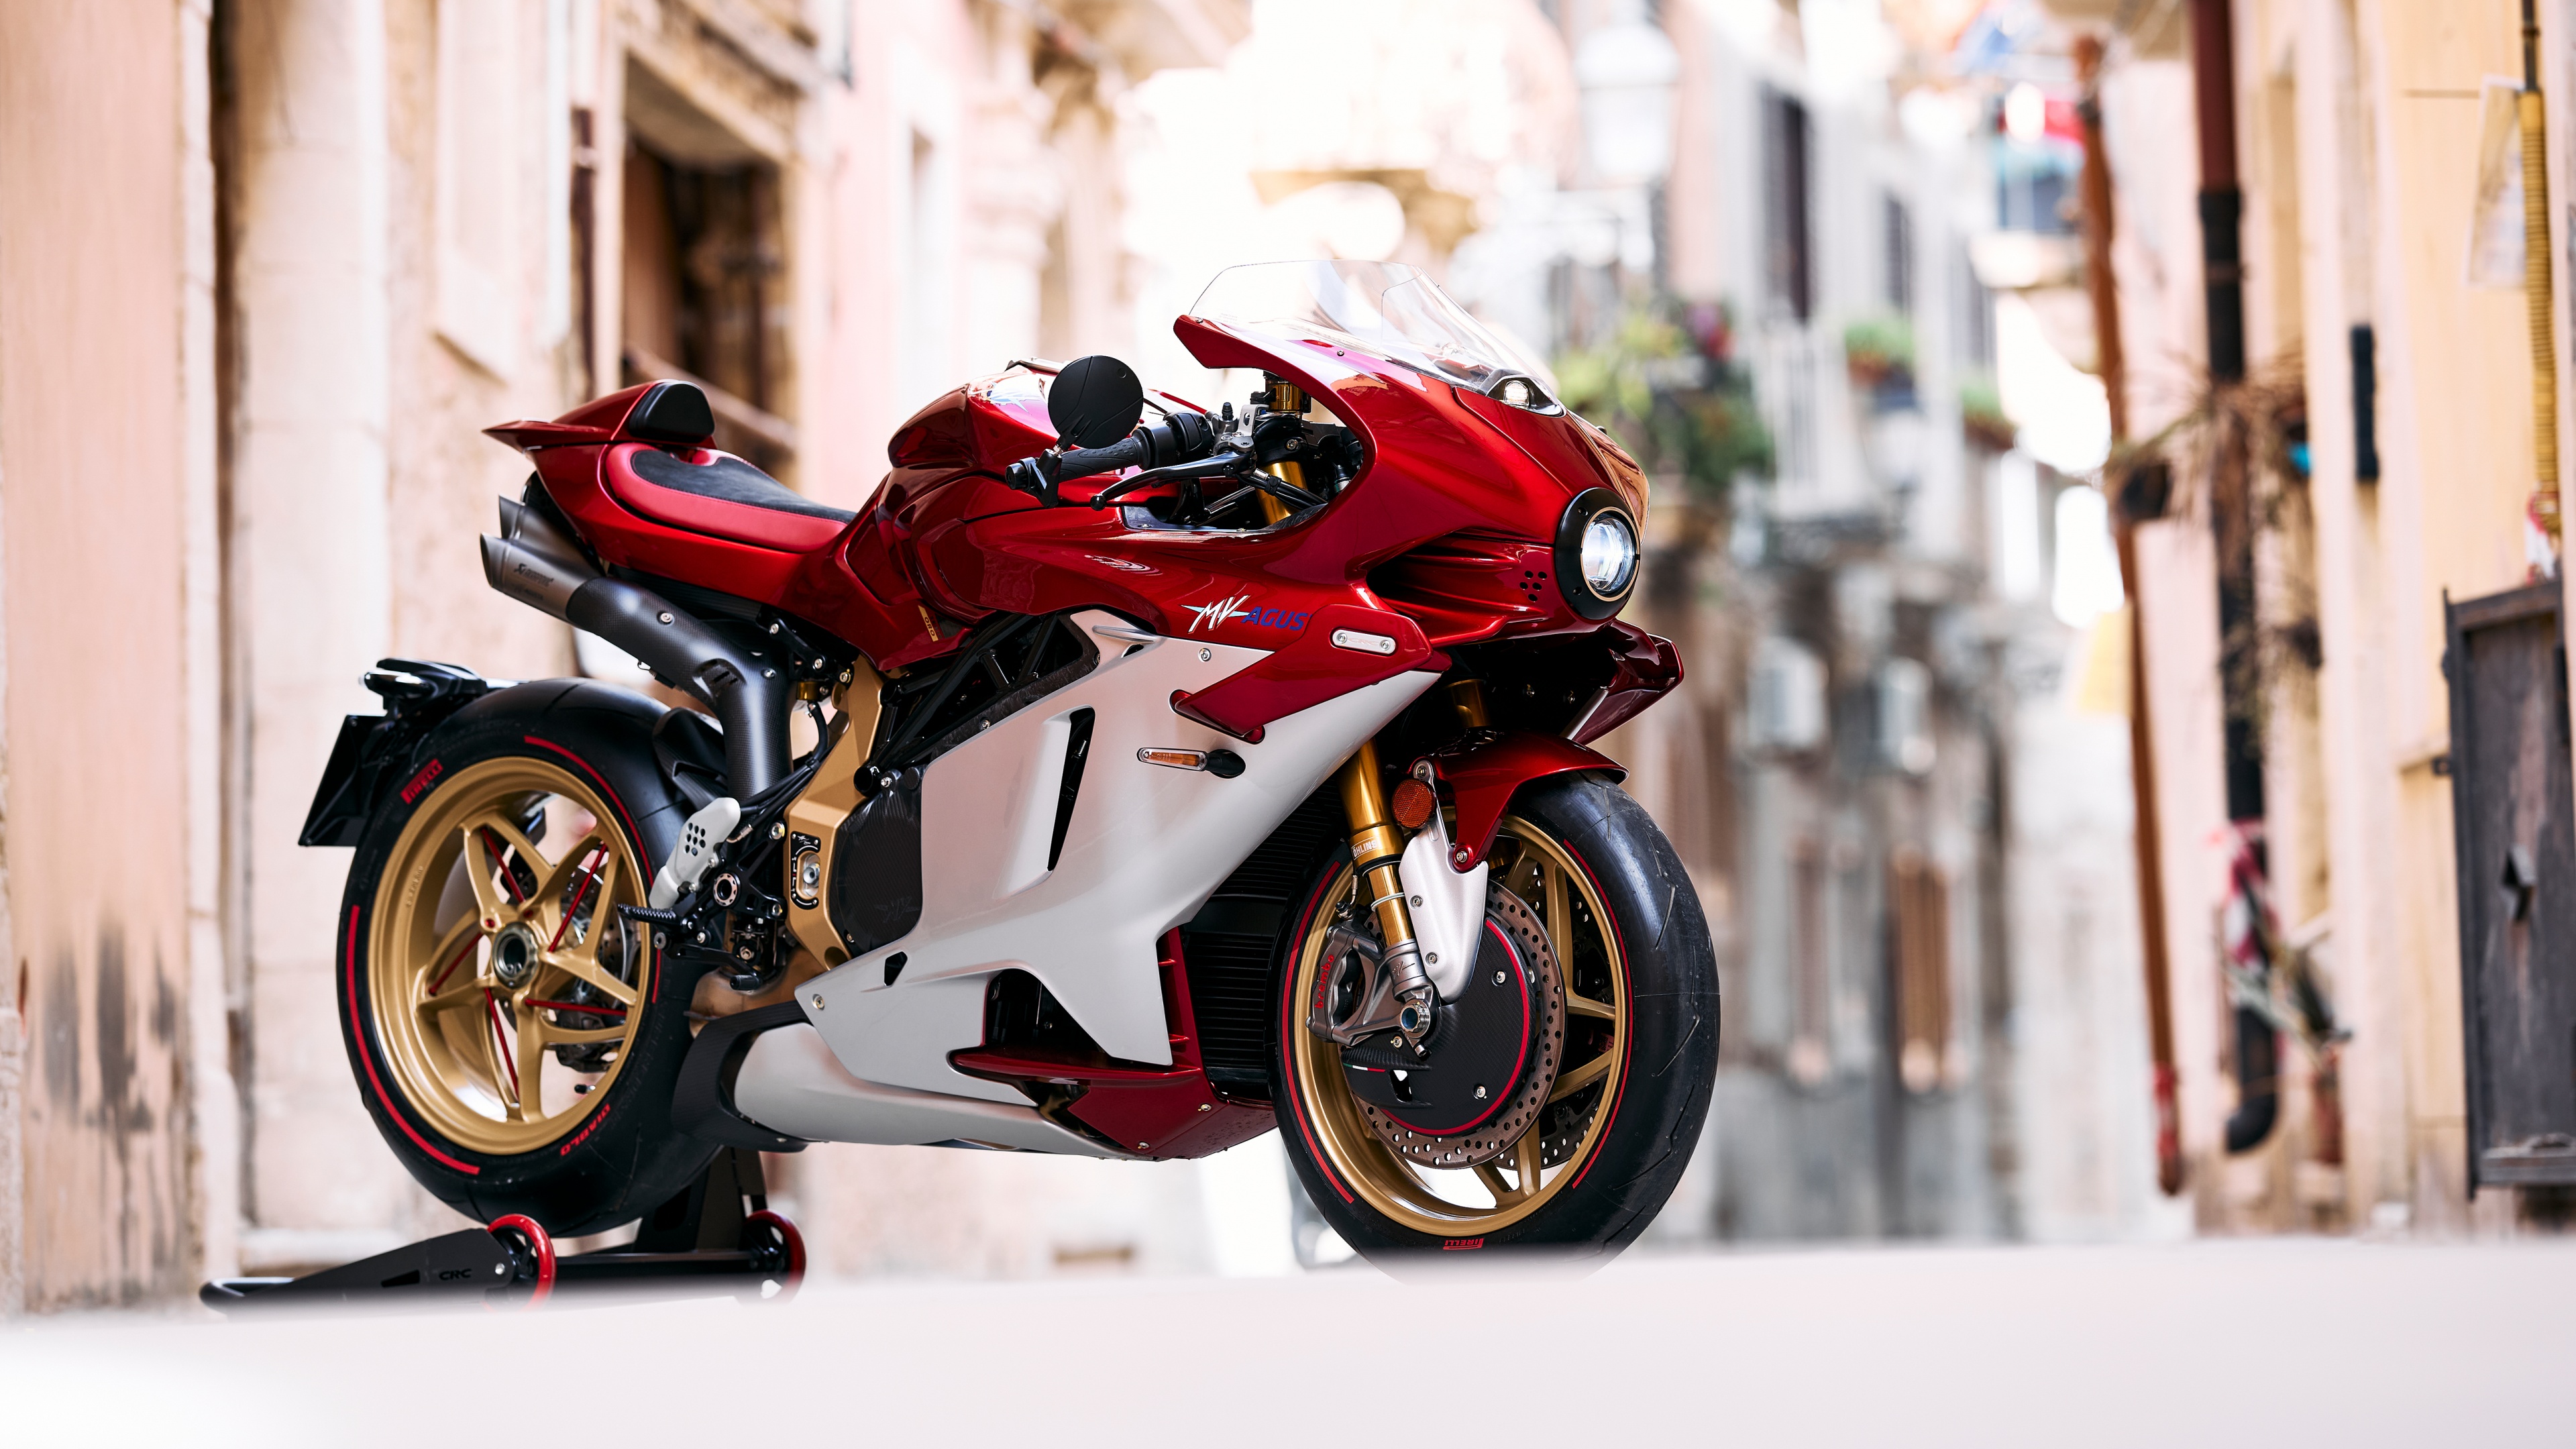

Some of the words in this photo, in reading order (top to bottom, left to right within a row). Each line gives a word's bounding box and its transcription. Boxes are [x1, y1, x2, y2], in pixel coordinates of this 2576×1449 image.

[924, 616, 935, 637] ORO
[1187, 594, 1251, 634] MV
[1241, 606, 1312, 631] AGUS
[400, 758, 443, 804] PIRELLI
[1314, 955, 1335, 1009] brembo
[559, 1102, 611, 1157] DIABLO
[1443, 1238, 1484, 1250] PIRELLI
[438, 1268, 472, 1281] CRC
